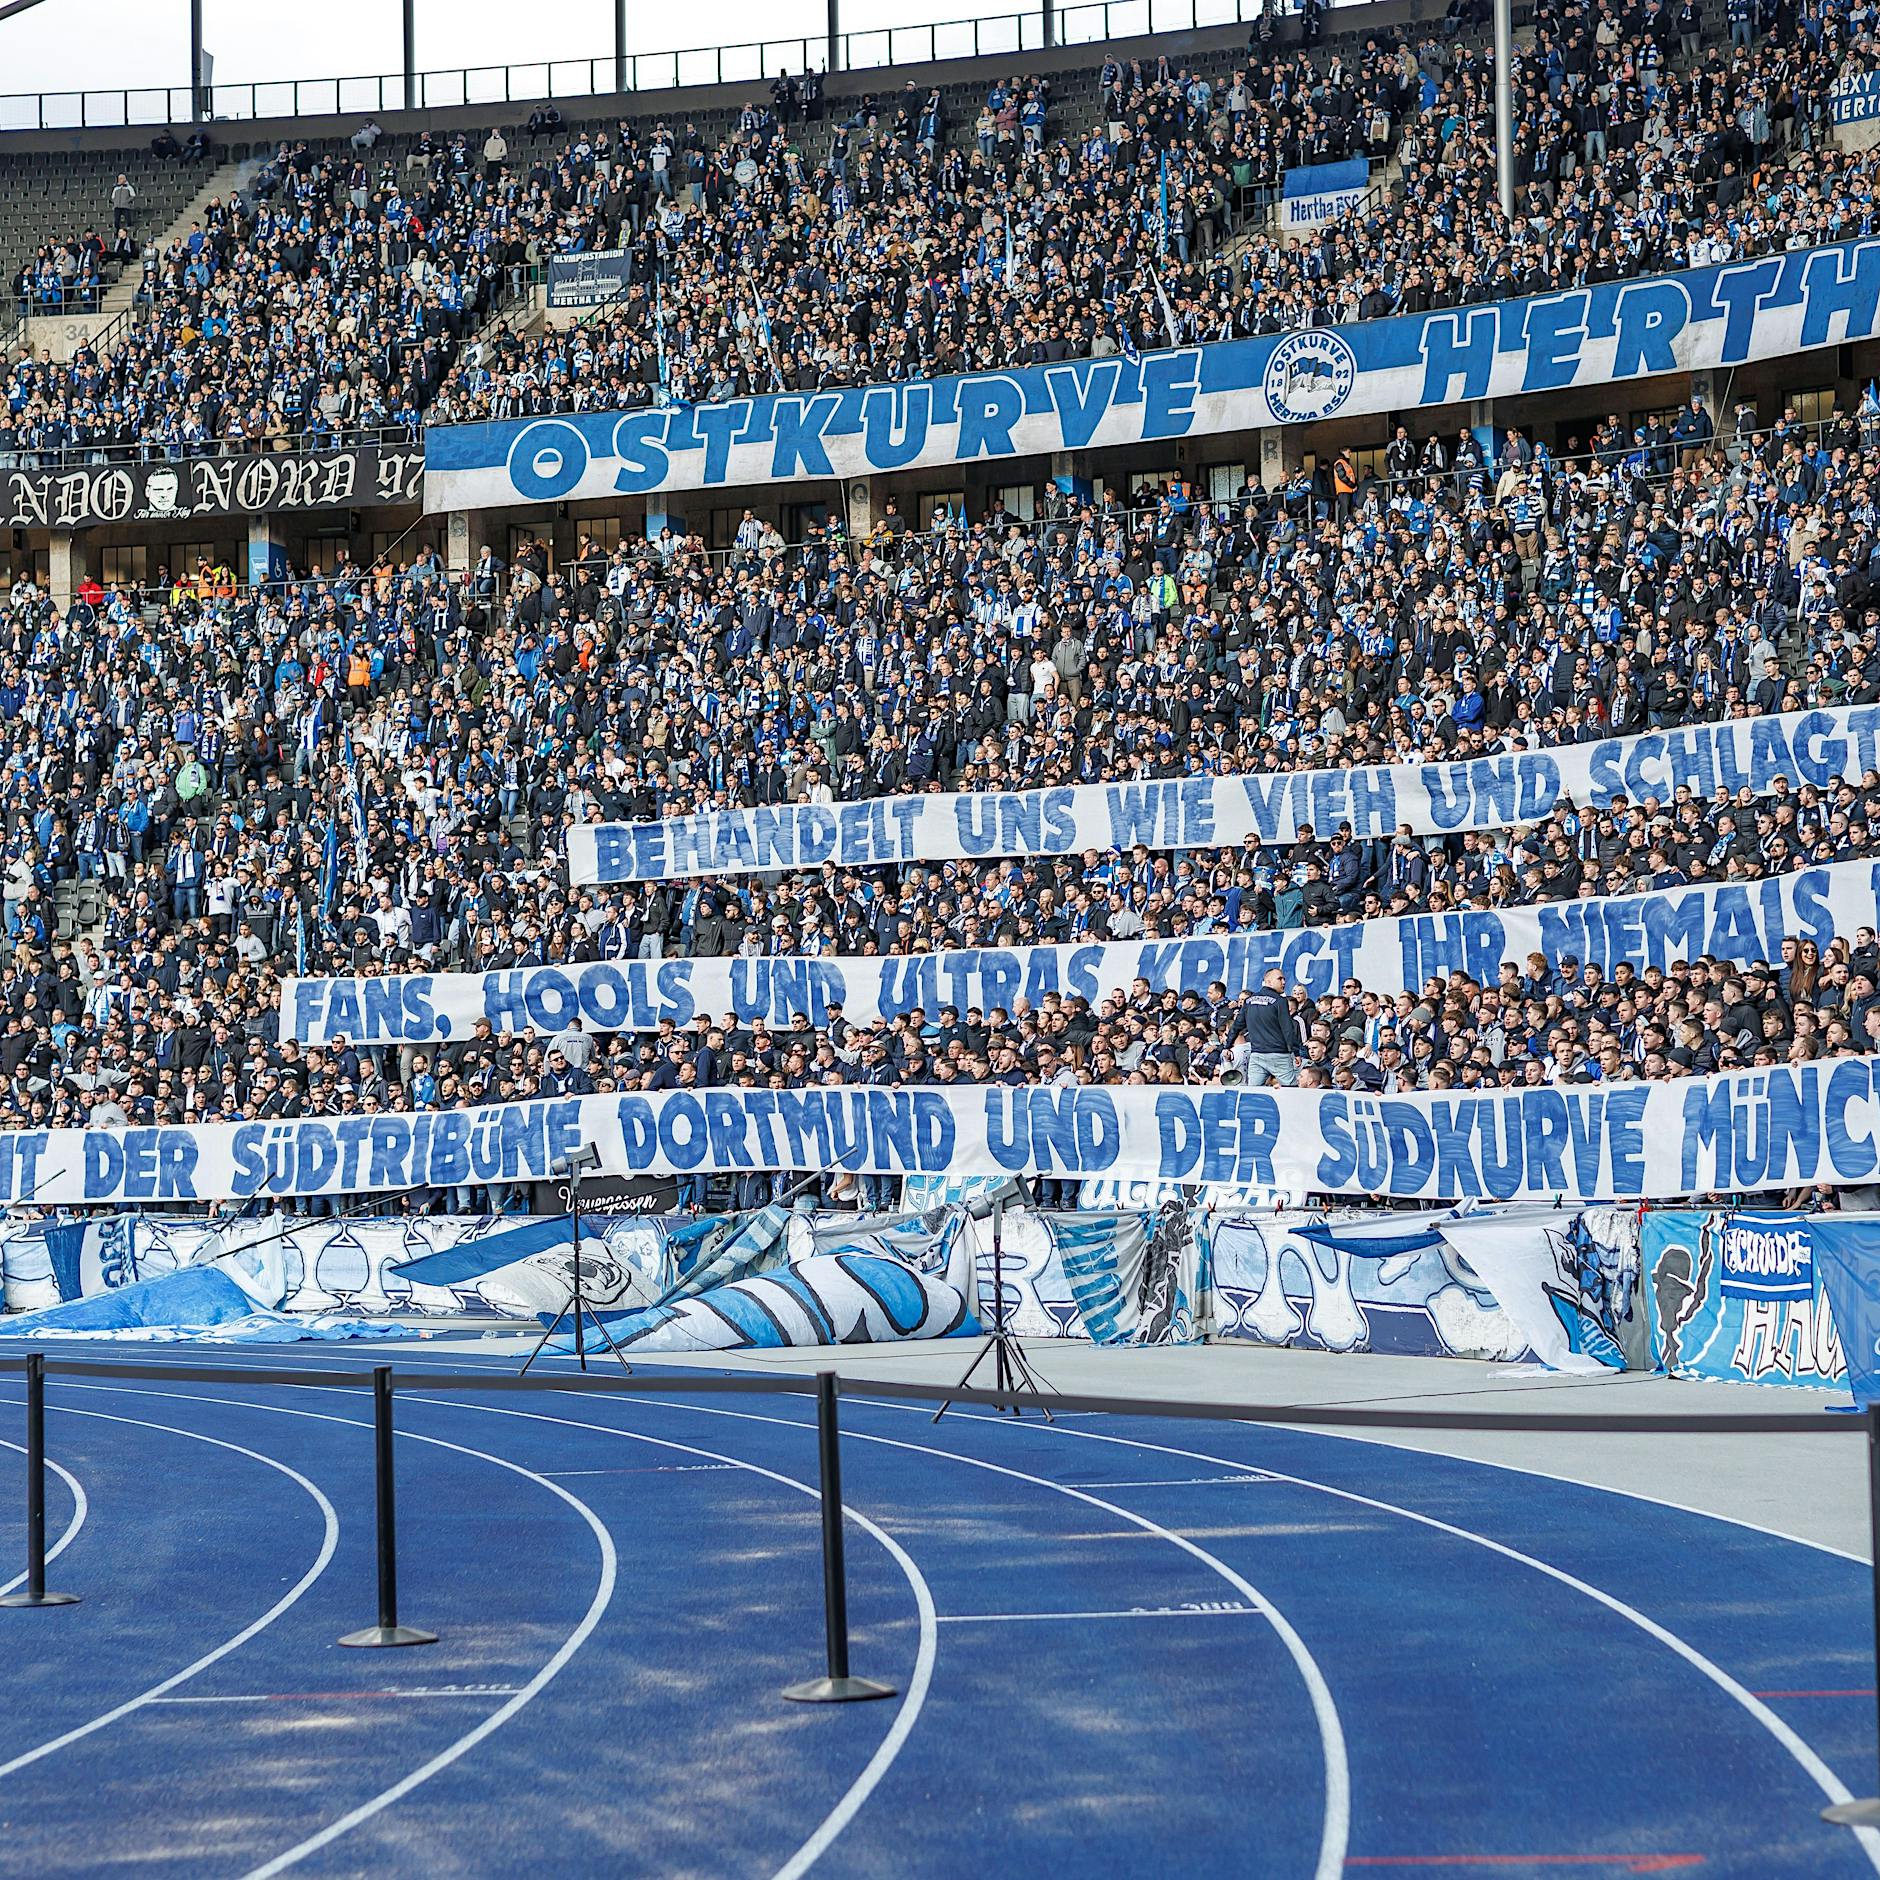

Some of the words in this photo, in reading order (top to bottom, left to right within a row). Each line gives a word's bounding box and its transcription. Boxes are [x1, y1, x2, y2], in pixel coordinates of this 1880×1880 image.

[1829, 71, 1874, 98] SEXY
[1828, 94, 1880, 122] HERT
[1290, 197, 1333, 222] Hertha
[553, 249, 625, 264] OLYMPIASTADION
[553, 295, 591, 306] HERTHA
[65, 323, 90, 341] 34
[1274, 335, 1347, 373] OSTKURVE
[1271, 379, 1283, 388] 18
[1335, 369, 1349, 379] 92
[1269, 392, 1318, 421] HERTHA
[1322, 384, 1348, 415] BSC
[505, 348, 1203, 502] OSTKURVE
[1263, 439, 1278, 460] R
[0, 468, 134, 527] NDO
[191, 451, 359, 514] NORD
[851, 483, 868, 504] Q
[594, 796, 925, 882] BEHANDELT
[955, 789, 1077, 854] UNS
[1107, 777, 1216, 853] WIE
[1242, 767, 1397, 840] VIEH
[1420, 754, 1561, 829] UND
[1588, 707, 1880, 809] SCHLAGT
[294, 976, 450, 1042] FANS,
[482, 960, 695, 1033] HOOLS
[729, 959, 848, 1029] UND
[877, 944, 1106, 1025] ULTRAS
[1137, 923, 1365, 1003] KRIEGT
[1398, 911, 1507, 995] IHR
[1537, 868, 1836, 985] NIEMALS
[83, 1128, 199, 1199] DER
[231, 1100, 583, 1197] SÜDTRIBÜNE
[616, 1089, 957, 1172] DORTMUND
[984, 1086, 1122, 1173] UND
[1154, 1089, 1282, 1187] DER
[1315, 1085, 1651, 1201] SÜDKURVE
[1680, 1058, 1880, 1192] MÜNC
